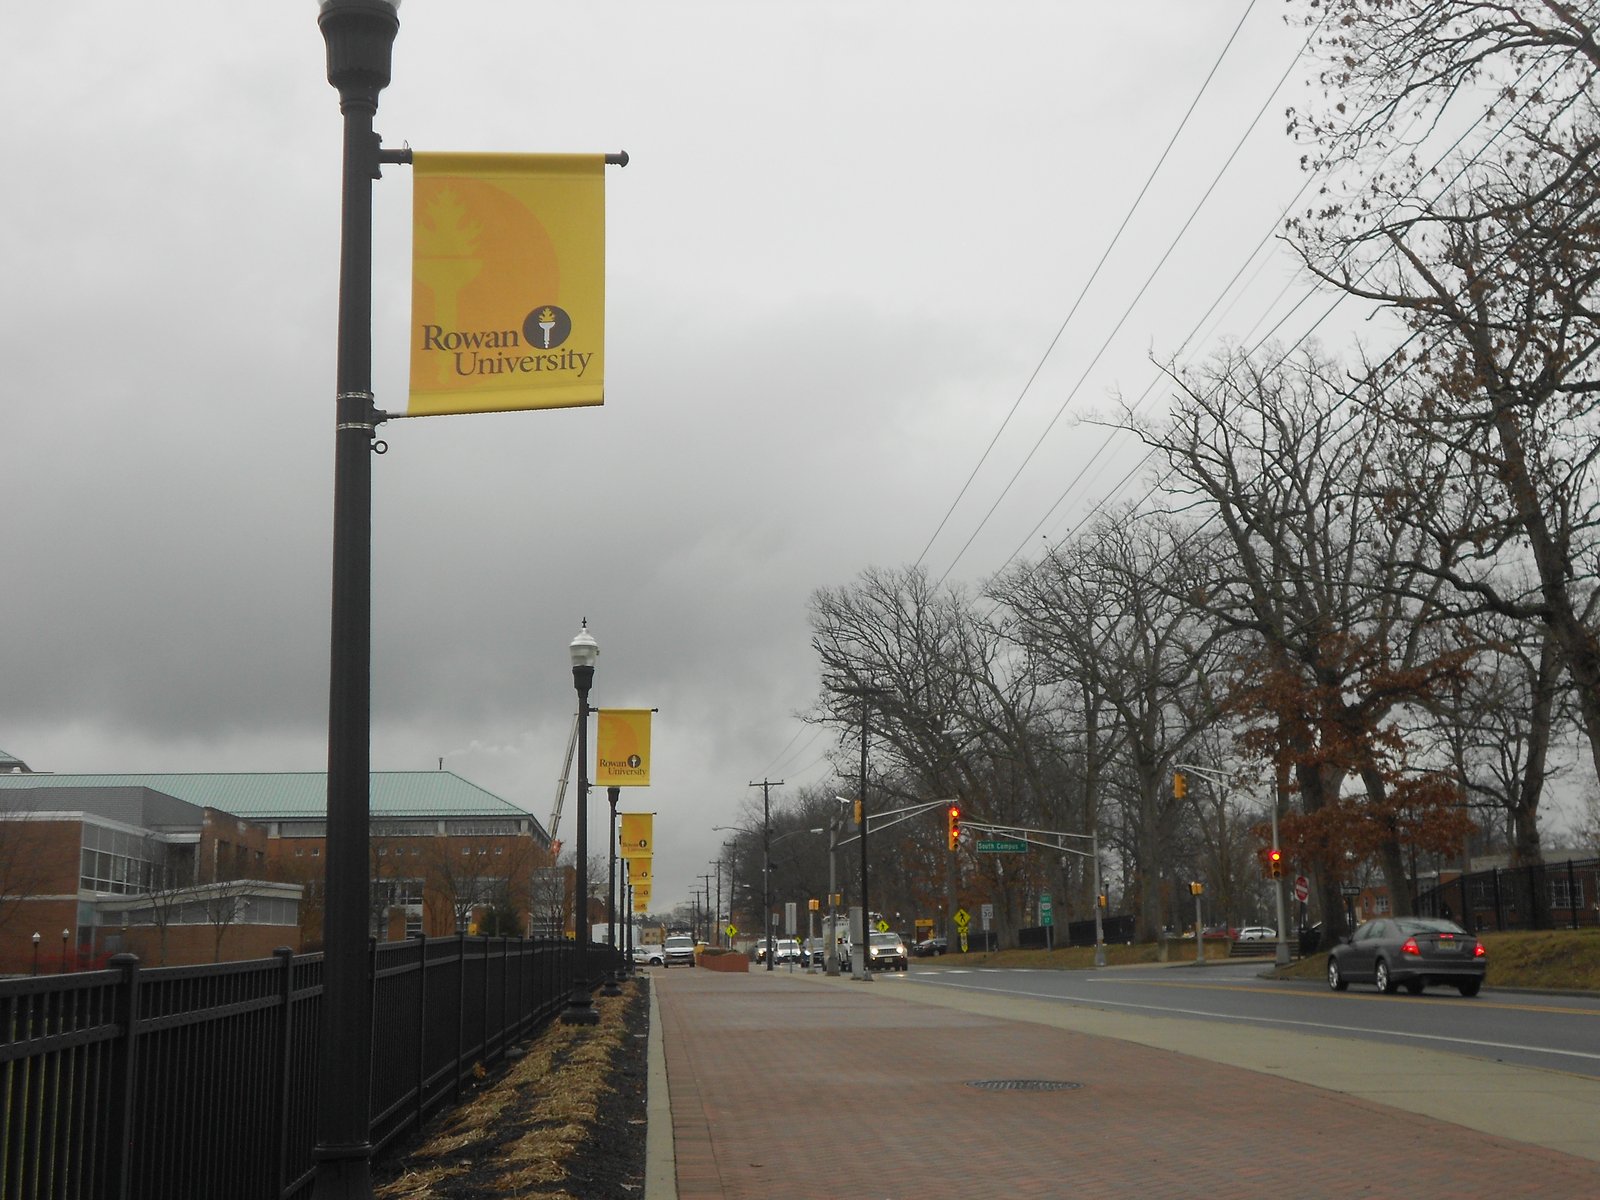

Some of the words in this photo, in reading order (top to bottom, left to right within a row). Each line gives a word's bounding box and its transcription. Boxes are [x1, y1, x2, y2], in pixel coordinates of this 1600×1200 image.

[422, 324, 520, 351] Rowan
[453, 348, 594, 378] University
[599, 758, 627, 767] Rowan
[608, 766, 647, 778] University
[978, 842, 995, 850] South
[996, 842, 1019, 851] Campus
